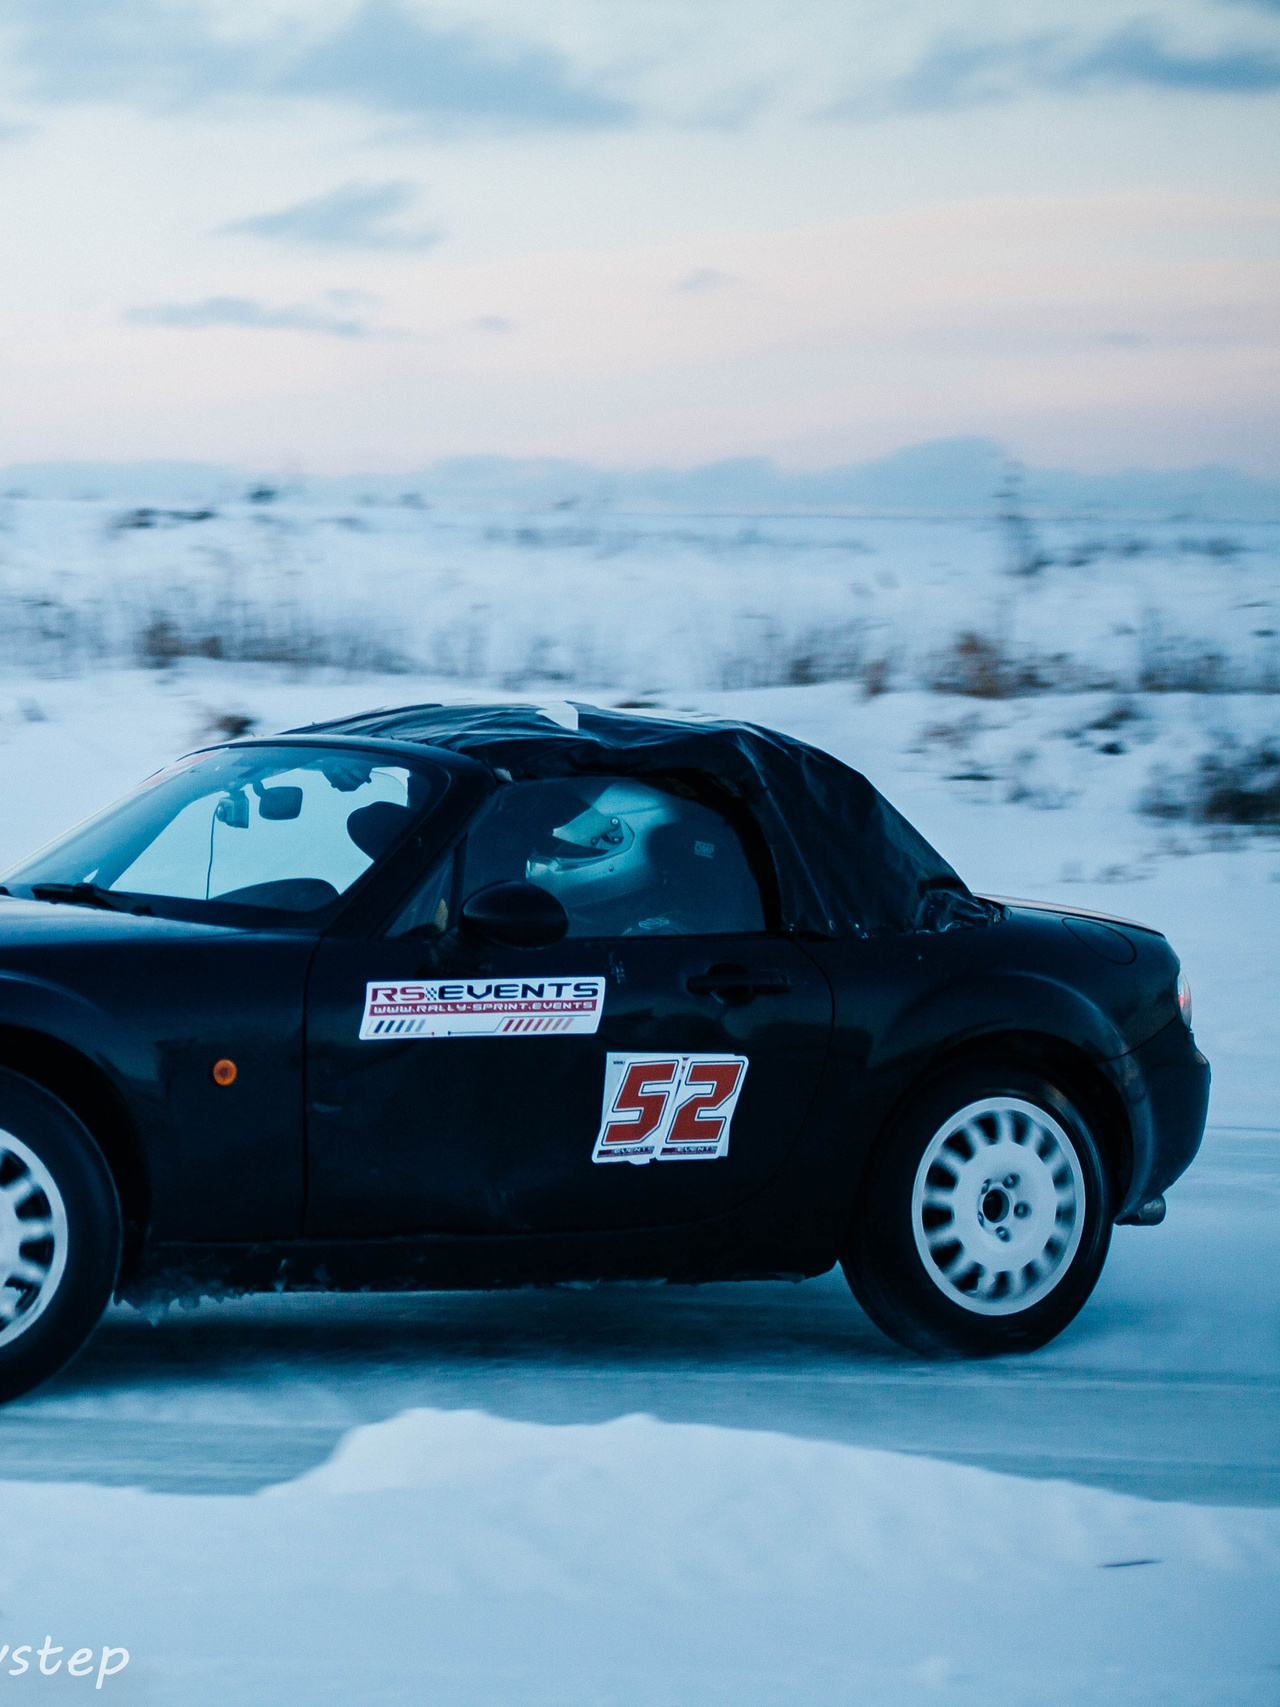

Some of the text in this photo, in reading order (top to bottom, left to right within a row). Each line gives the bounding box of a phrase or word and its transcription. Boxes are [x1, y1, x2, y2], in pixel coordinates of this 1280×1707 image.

[371, 982, 599, 1002] RS EVENTS
[373, 1001, 593, 1014] WWW.RALLY-SPRINT.EVENTS
[601, 1060, 746, 1146] 52
